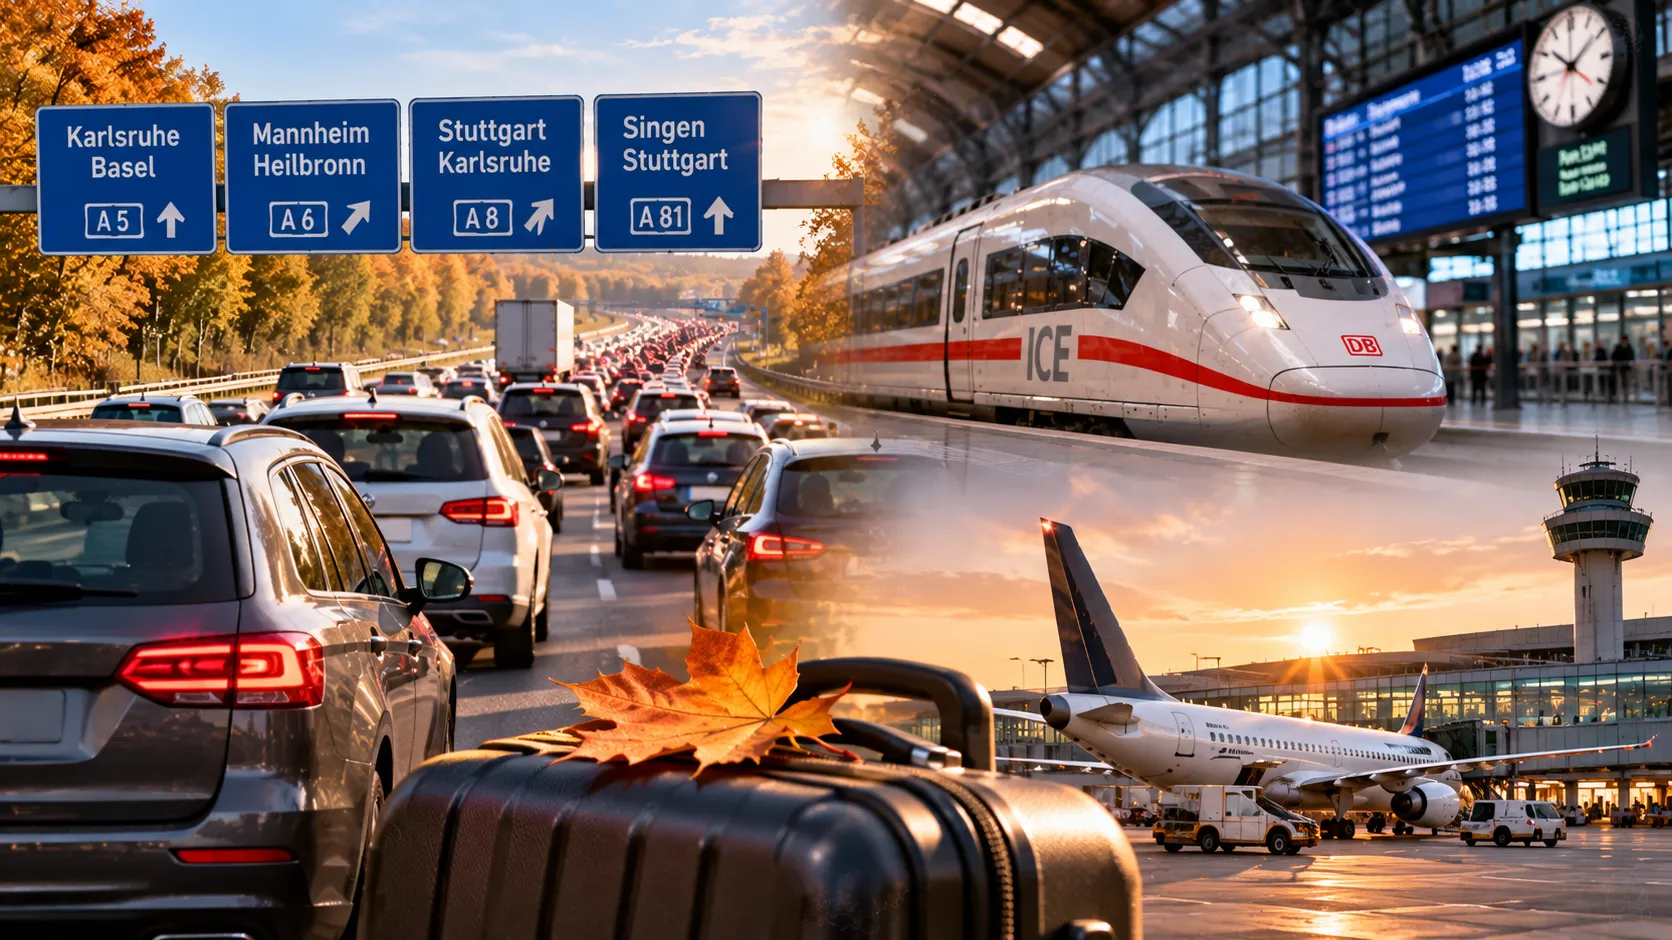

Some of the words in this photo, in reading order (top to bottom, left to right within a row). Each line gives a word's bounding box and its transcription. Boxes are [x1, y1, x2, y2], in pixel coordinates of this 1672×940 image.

[68, 124, 179, 147] Karlsruhe
[254, 121, 368, 144] Mannheim
[439, 119, 546, 146] Stuttgart
[624, 116, 704, 144] Singen
[92, 156, 155, 178] Basel
[255, 153, 365, 176] Heilbronn
[440, 150, 550, 173] Karlsruhe
[624, 149, 728, 176] Stuttgart
[97, 211, 111, 231] A
[118, 211, 128, 231] 5
[281, 209, 296, 230] A
[302, 209, 314, 230] 6
[466, 208, 480, 228] A
[486, 207, 498, 229] 8
[640, 206, 653, 227] A
[660, 206, 681, 228] 81
[1027, 325, 1072, 382] ICE
[1347, 338, 1377, 352] DB
